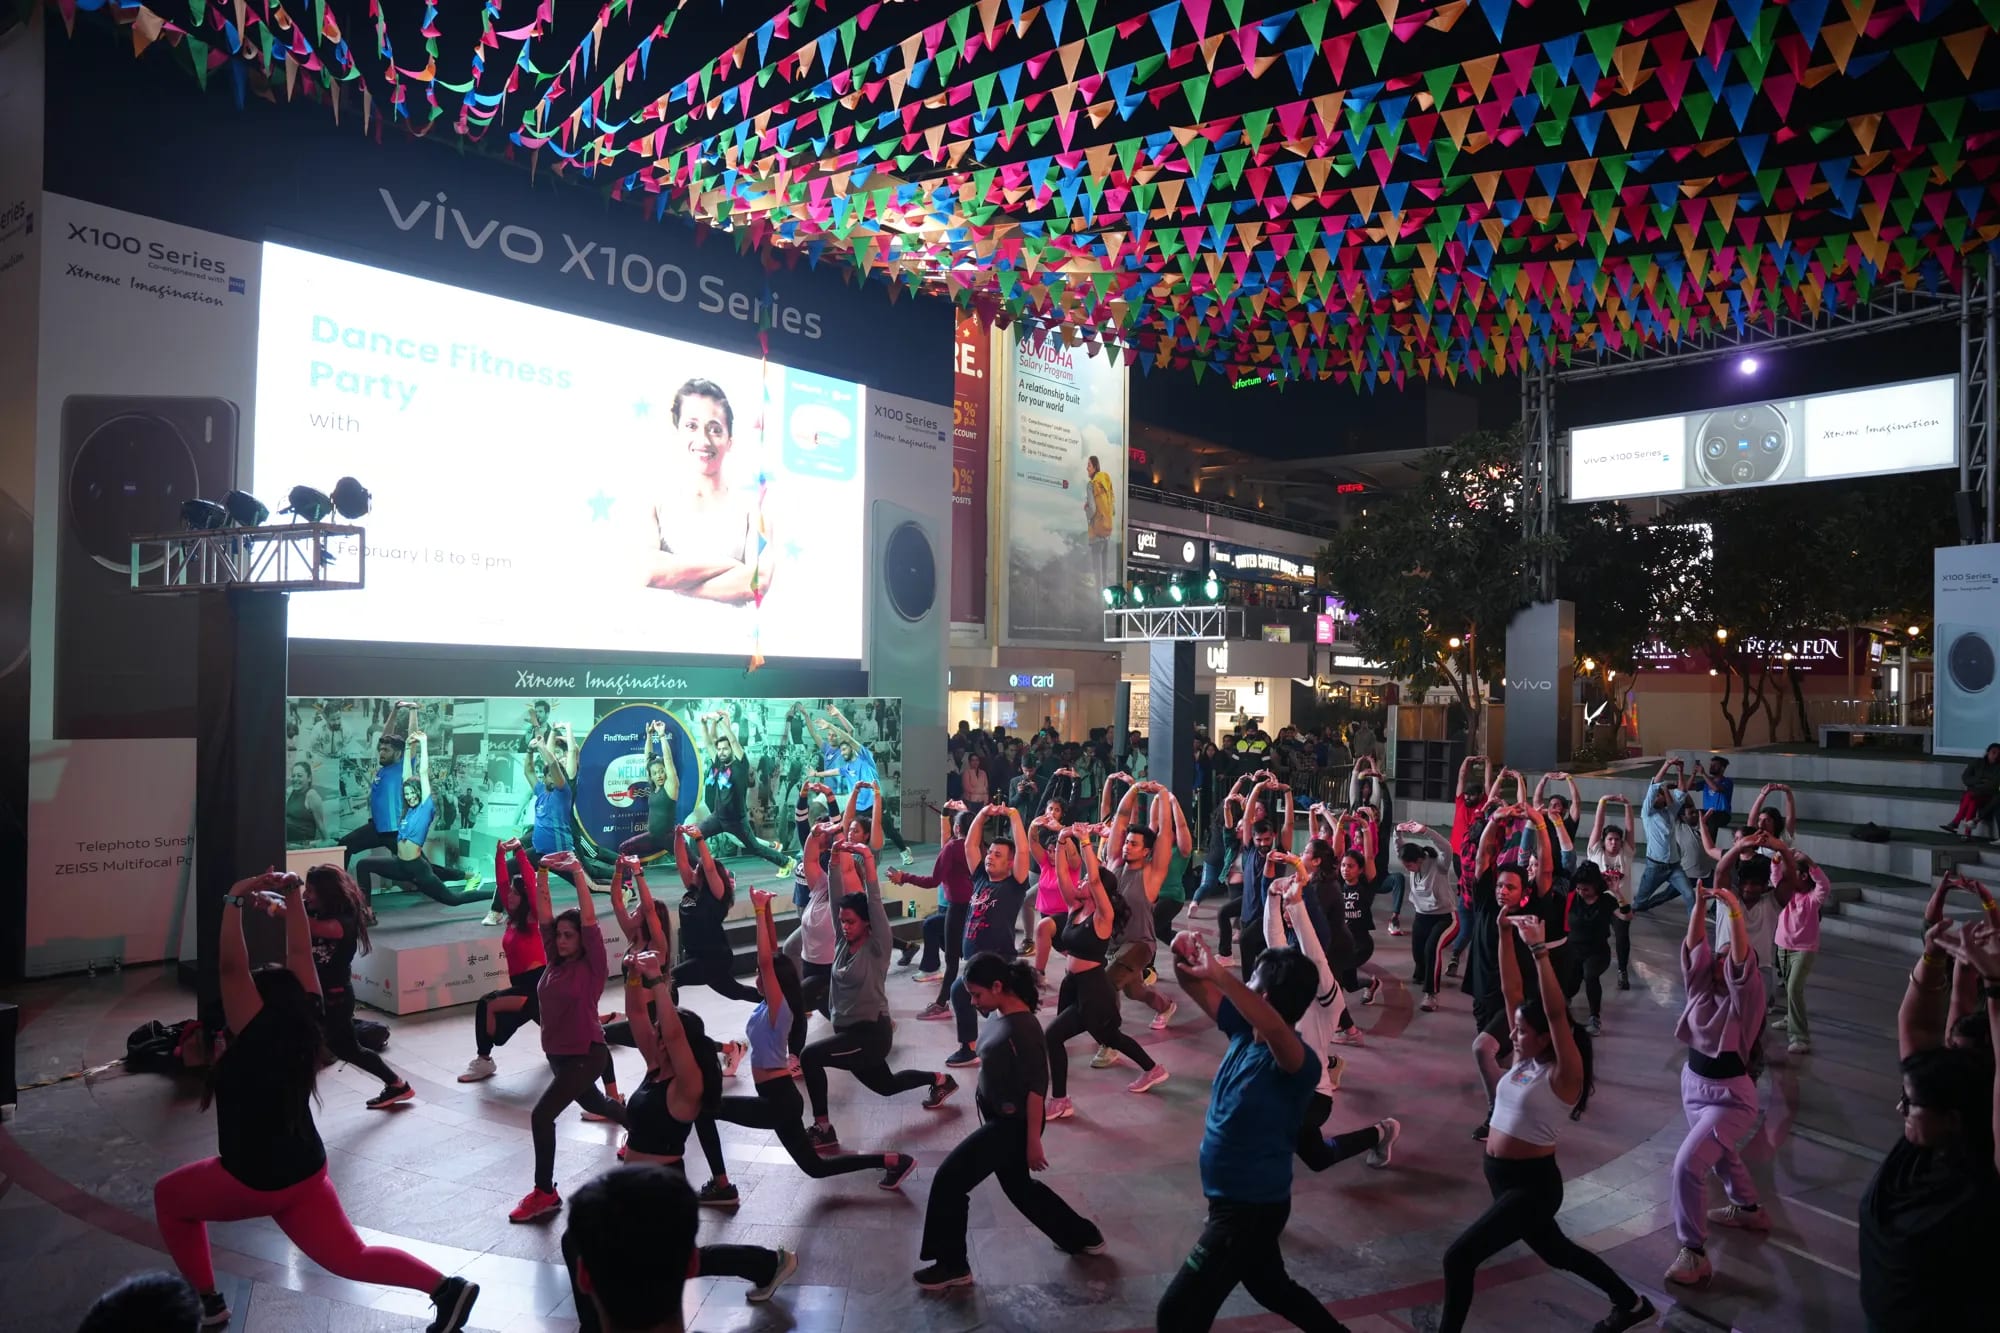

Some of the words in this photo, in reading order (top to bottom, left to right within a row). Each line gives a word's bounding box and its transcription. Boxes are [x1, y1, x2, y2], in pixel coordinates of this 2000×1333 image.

[67, 222, 141, 254] X100
[148, 242, 226, 274] Series
[379, 188, 544, 264] vivo
[560, 233, 688, 303] X100
[698, 274, 822, 339] Series
[130, 276, 224, 306] Imagination
[312, 315, 439, 363] Dance
[449, 343, 573, 389] Fitness
[1020, 338, 1073, 369] SUVIDHA
[1019, 355, 1043, 373] Salary
[1044, 363, 1073, 381] Program
[310, 360, 418, 411] Party
[1018, 379, 1024, 389] A
[1025, 382, 1065, 401] relationship
[1066, 392, 1080, 406] built
[1238, 377, 1262, 389] fortum
[1018, 392, 1028, 403] for
[1029, 397, 1044, 407] your
[1045, 402, 1064, 413] world
[310, 411, 360, 432] with
[874, 404, 903, 421] X100
[905, 412, 938, 430] Series
[953, 429, 977, 440] CCOUNT
[1634, 449, 1662, 459] Series
[1137, 532, 1157, 551] yeti
[450, 552, 465, 565] to
[485, 556, 512, 570] pm
[1803, 638, 1843, 659] FUN
[585, 671, 688, 695] Imagination
[1031, 673, 1054, 687] card
[1511, 678, 1552, 690] vivo
[603, 733, 639, 742] FindYourFit
[76, 839, 151, 853] Telephoto
[55, 861, 99, 875] ZEISS
[103, 856, 172, 872] Multifocal
